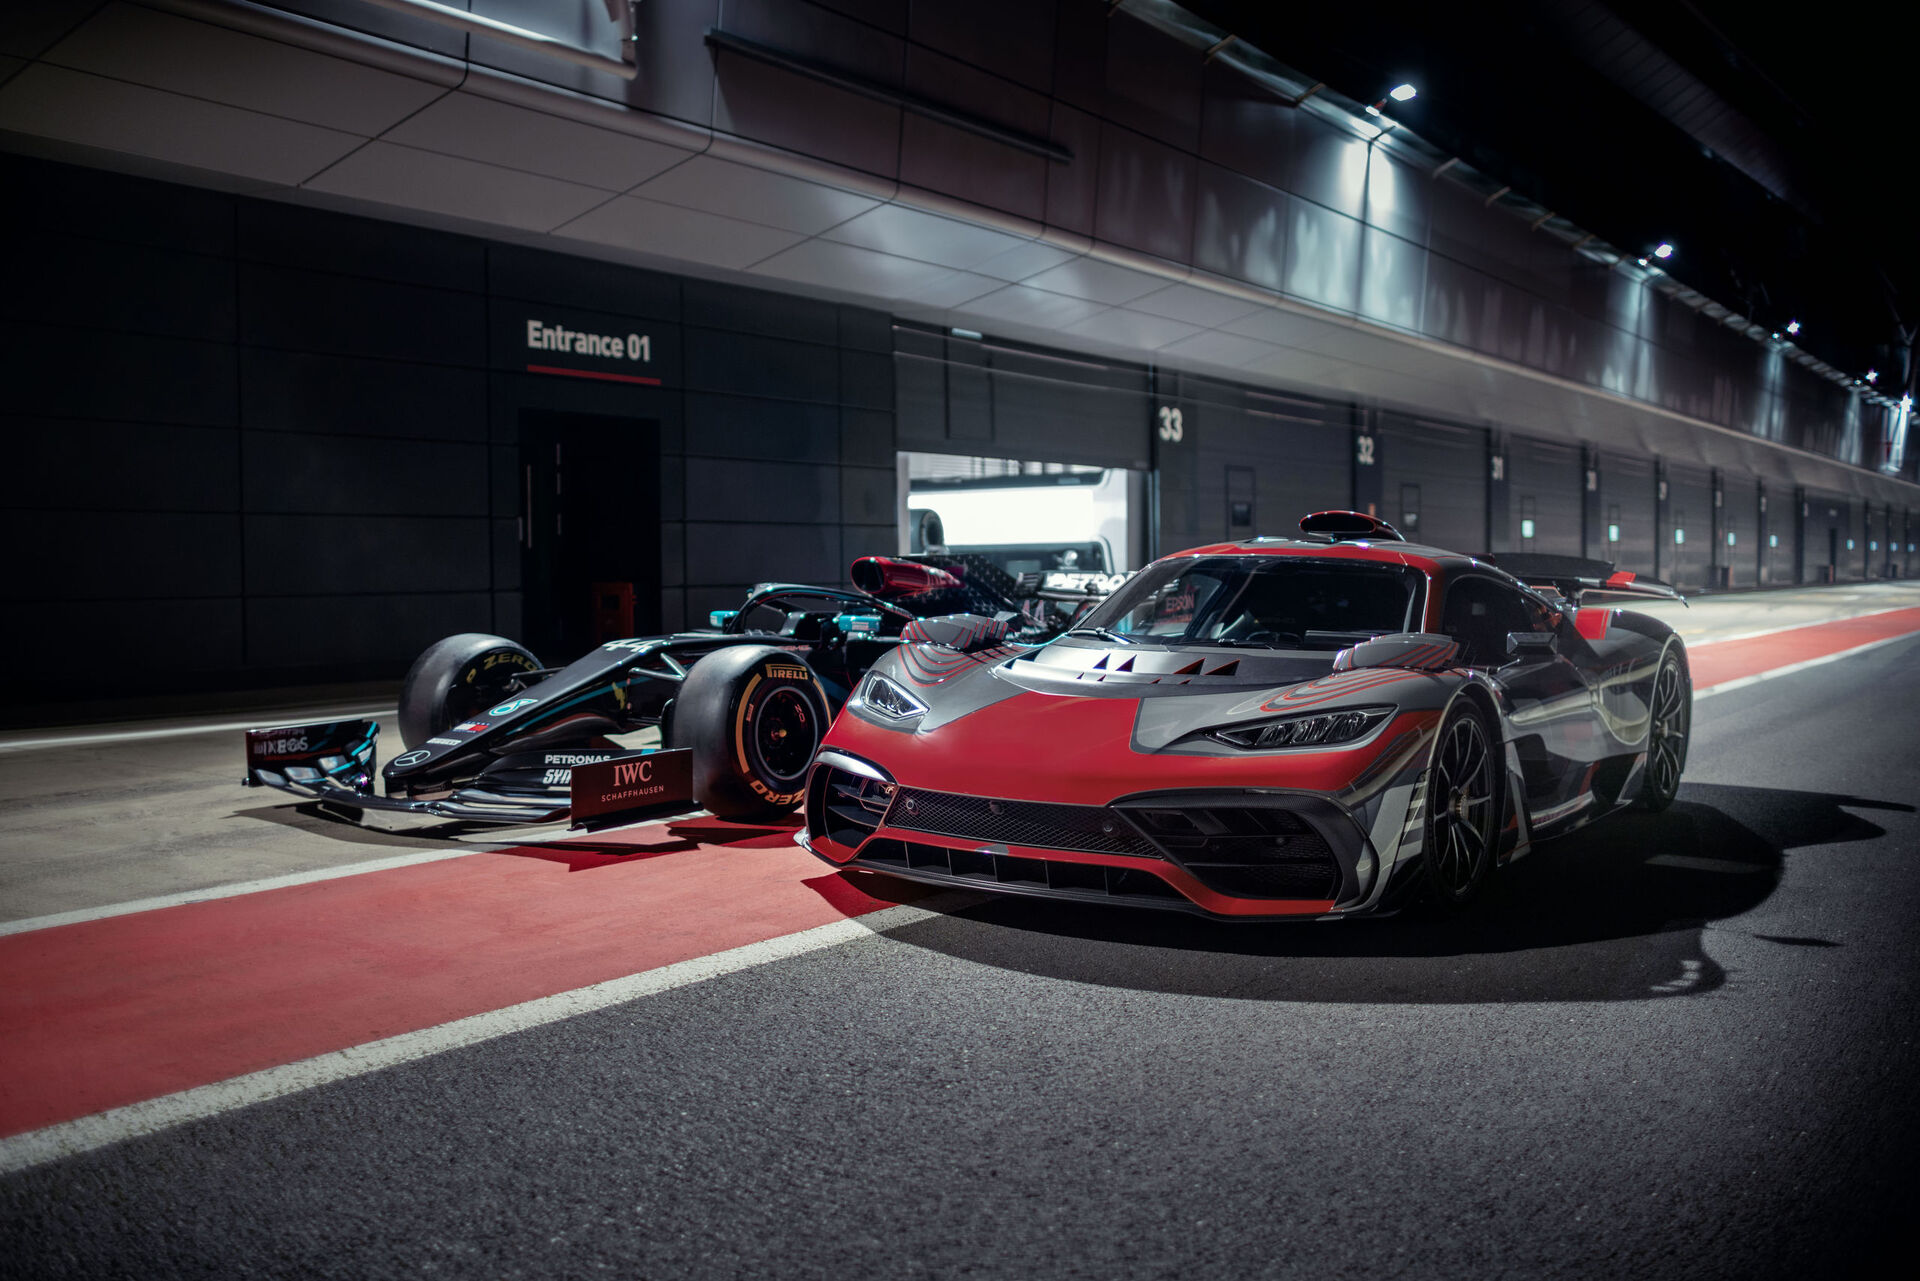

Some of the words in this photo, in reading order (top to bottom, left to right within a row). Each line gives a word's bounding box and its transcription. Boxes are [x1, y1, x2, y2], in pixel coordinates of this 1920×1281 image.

[527, 319, 625, 359] Entrance
[626, 333, 651, 363] 01
[1158, 406, 1184, 443] 33
[1357, 435, 1376, 466] 32
[483, 652, 538, 672] ZERO
[765, 663, 809, 681] PIRELLI
[544, 753, 612, 766] PETRONAS
[612, 760, 654, 787] IWC
[600, 784, 665, 803] SCHAFFHAUSEN
[749, 779, 806, 806] ZERO
